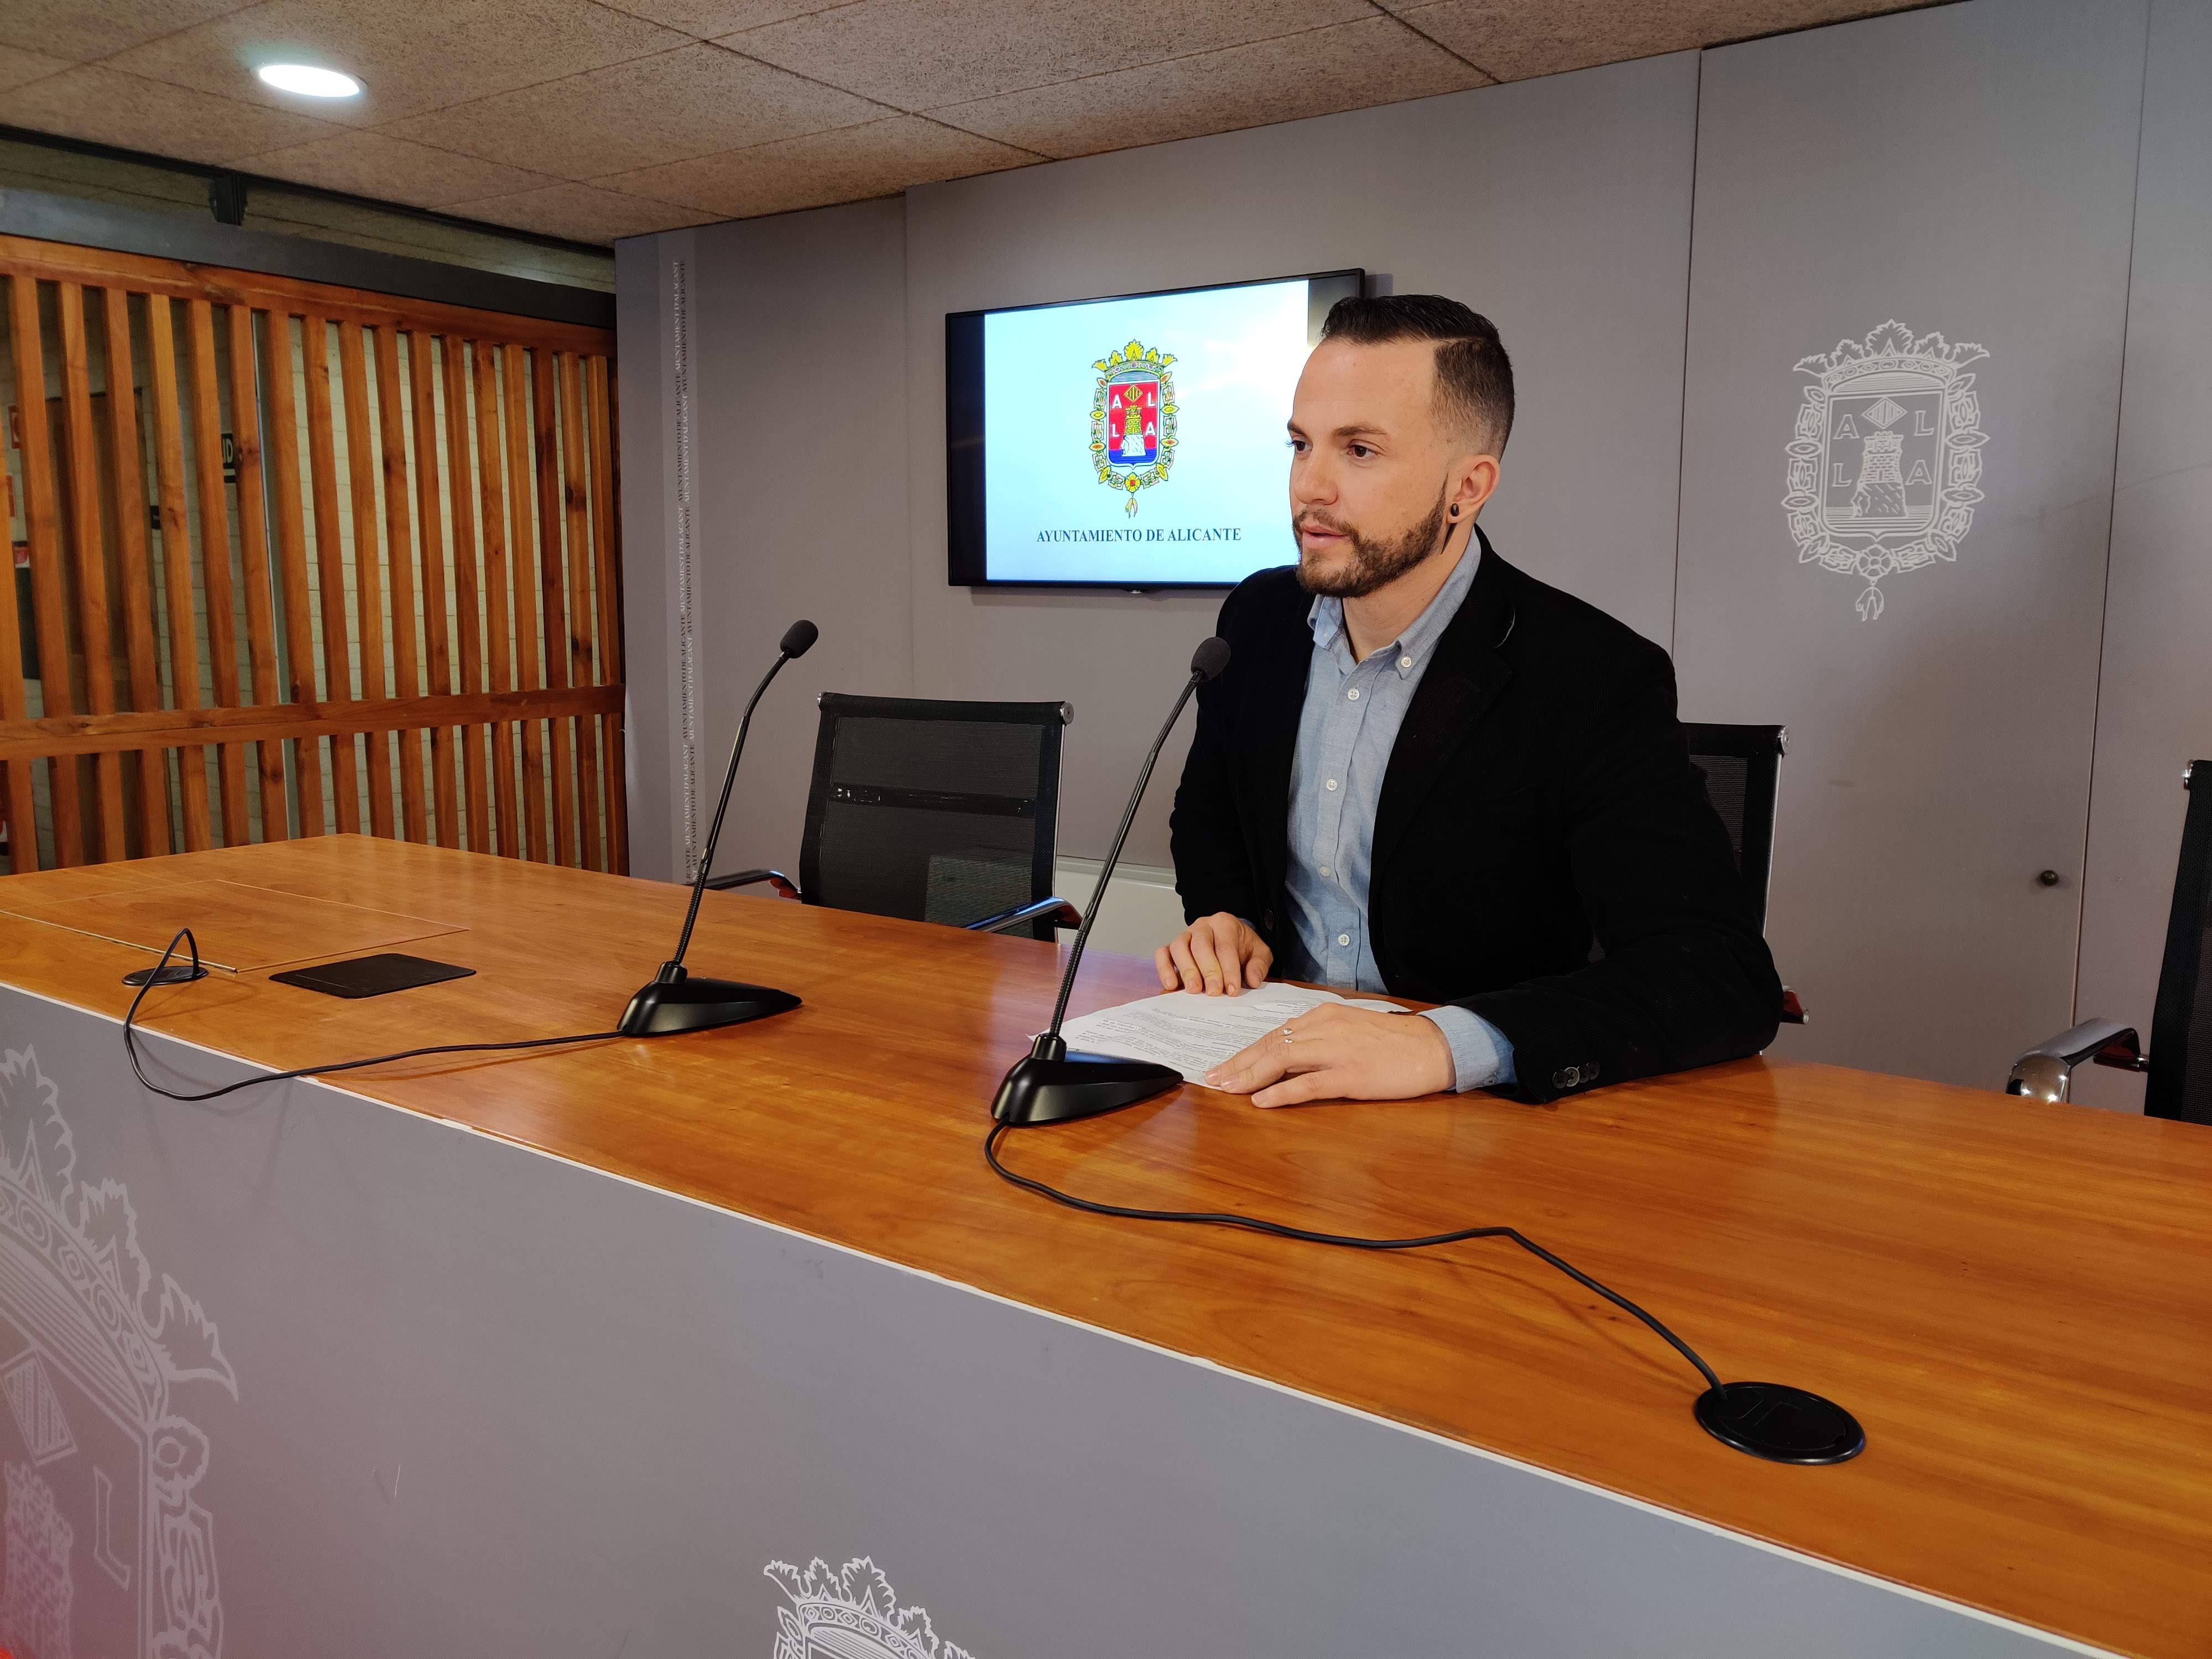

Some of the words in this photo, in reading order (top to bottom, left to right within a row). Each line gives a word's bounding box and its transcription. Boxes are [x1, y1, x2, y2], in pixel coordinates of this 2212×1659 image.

[1112, 394, 1122, 409] A
[1147, 392, 1156, 407] L
[1112, 423, 1120, 437] L
[1145, 421, 1156, 436] A
[1834, 414, 1859, 440] A
[1914, 410, 1934, 436] L
[1832, 463, 1852, 487] L
[1905, 460, 1932, 486] A
[1036, 529, 1142, 542] AYUNTAMIENTO
[1146, 529, 1164, 542] DE
[1167, 528, 1241, 541] ALICANTE
